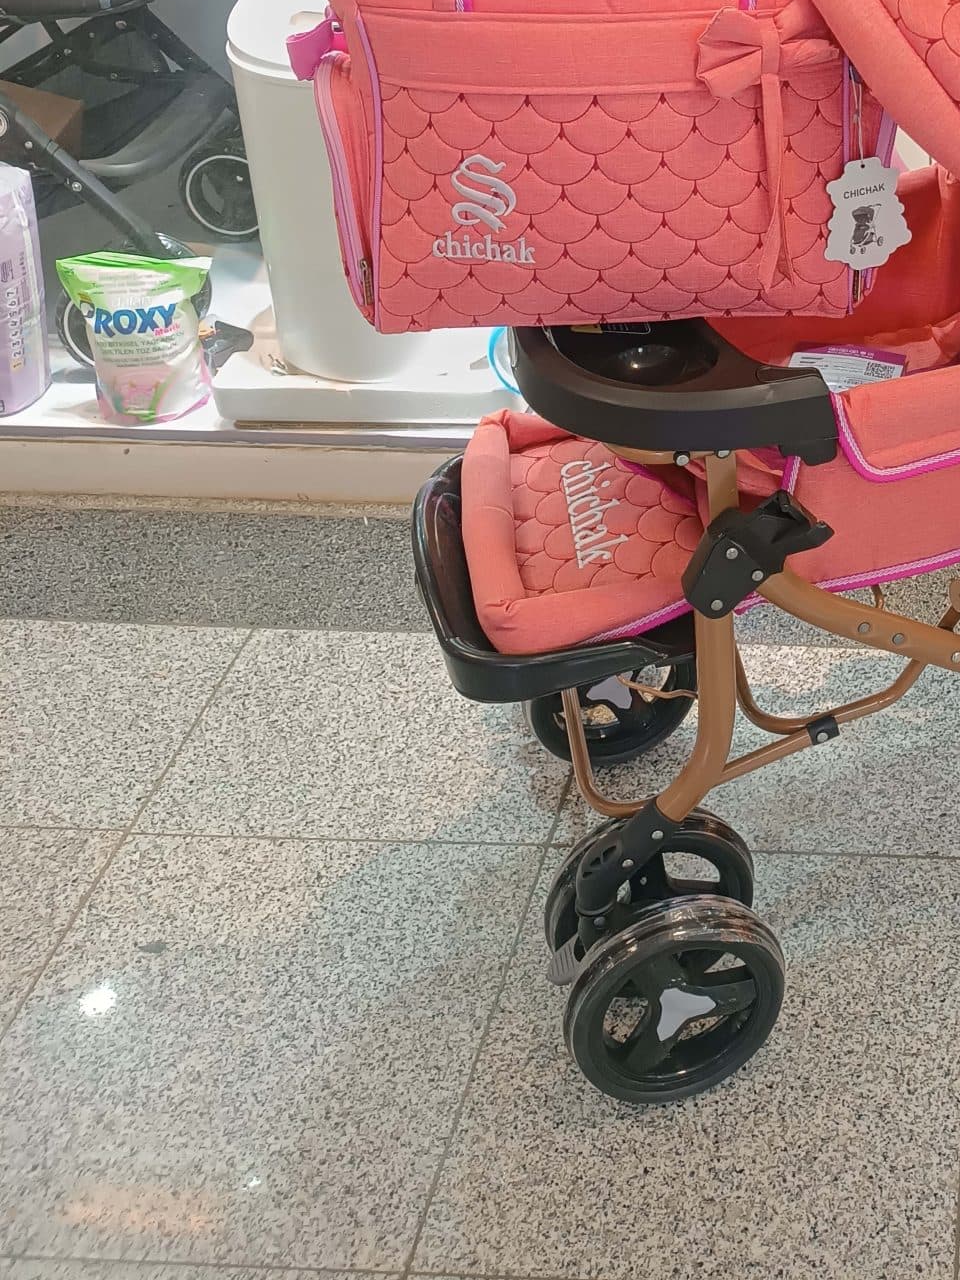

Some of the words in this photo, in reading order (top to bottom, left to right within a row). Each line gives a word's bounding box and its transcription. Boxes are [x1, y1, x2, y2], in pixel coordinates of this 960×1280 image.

[844, 183, 885, 200] CHICHAK
[433, 231, 536, 264] chichak
[95, 303, 177, 338] ROXY
[560, 460, 629, 569] chichak
